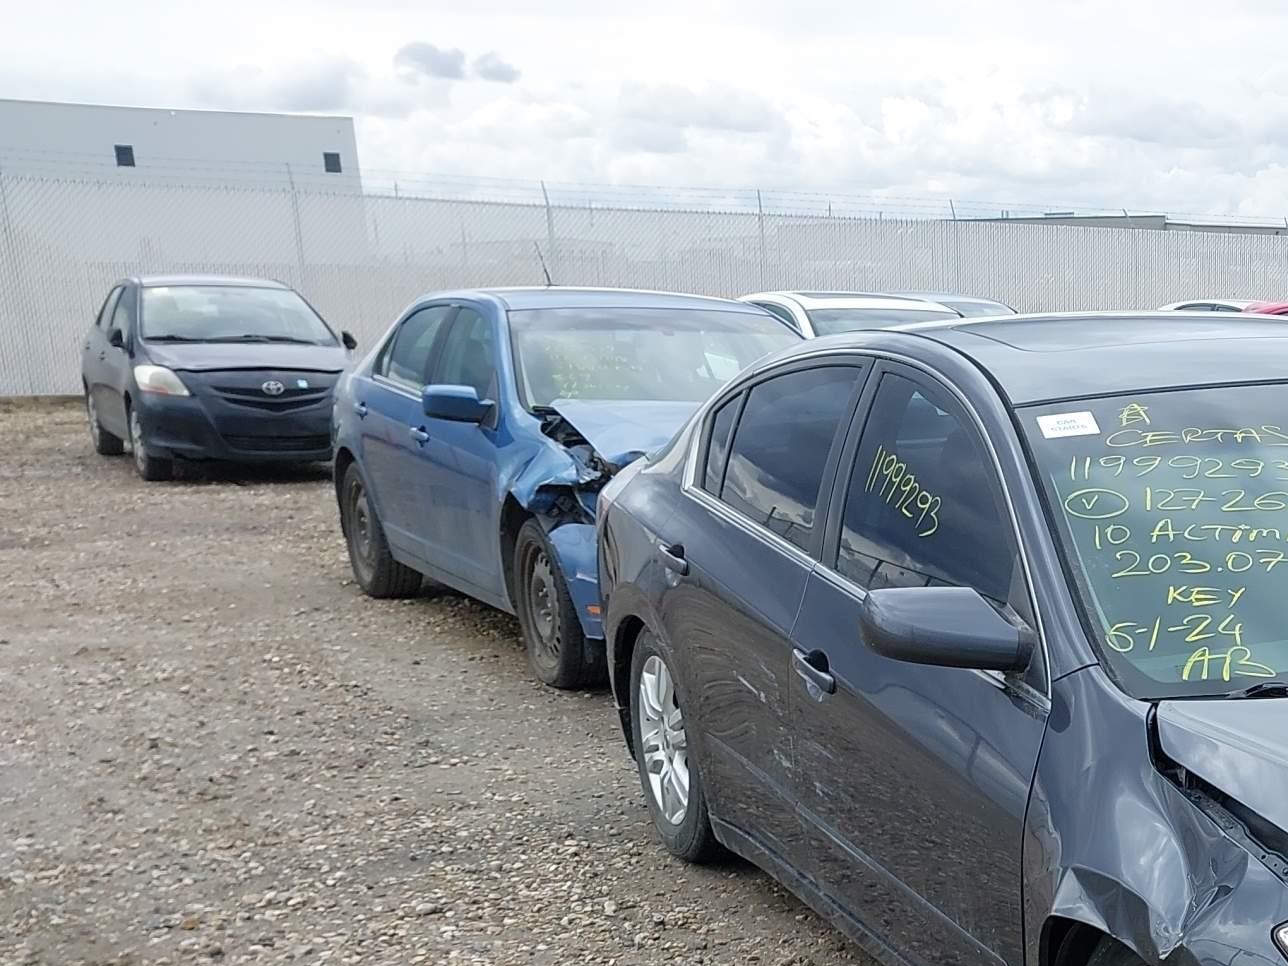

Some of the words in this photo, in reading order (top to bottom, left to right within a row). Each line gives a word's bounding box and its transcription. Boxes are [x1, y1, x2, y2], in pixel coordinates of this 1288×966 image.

[864, 445, 941, 537] 11999293
[1095, 523, 1130, 550] 10
[1167, 585, 1246, 608] KEY
